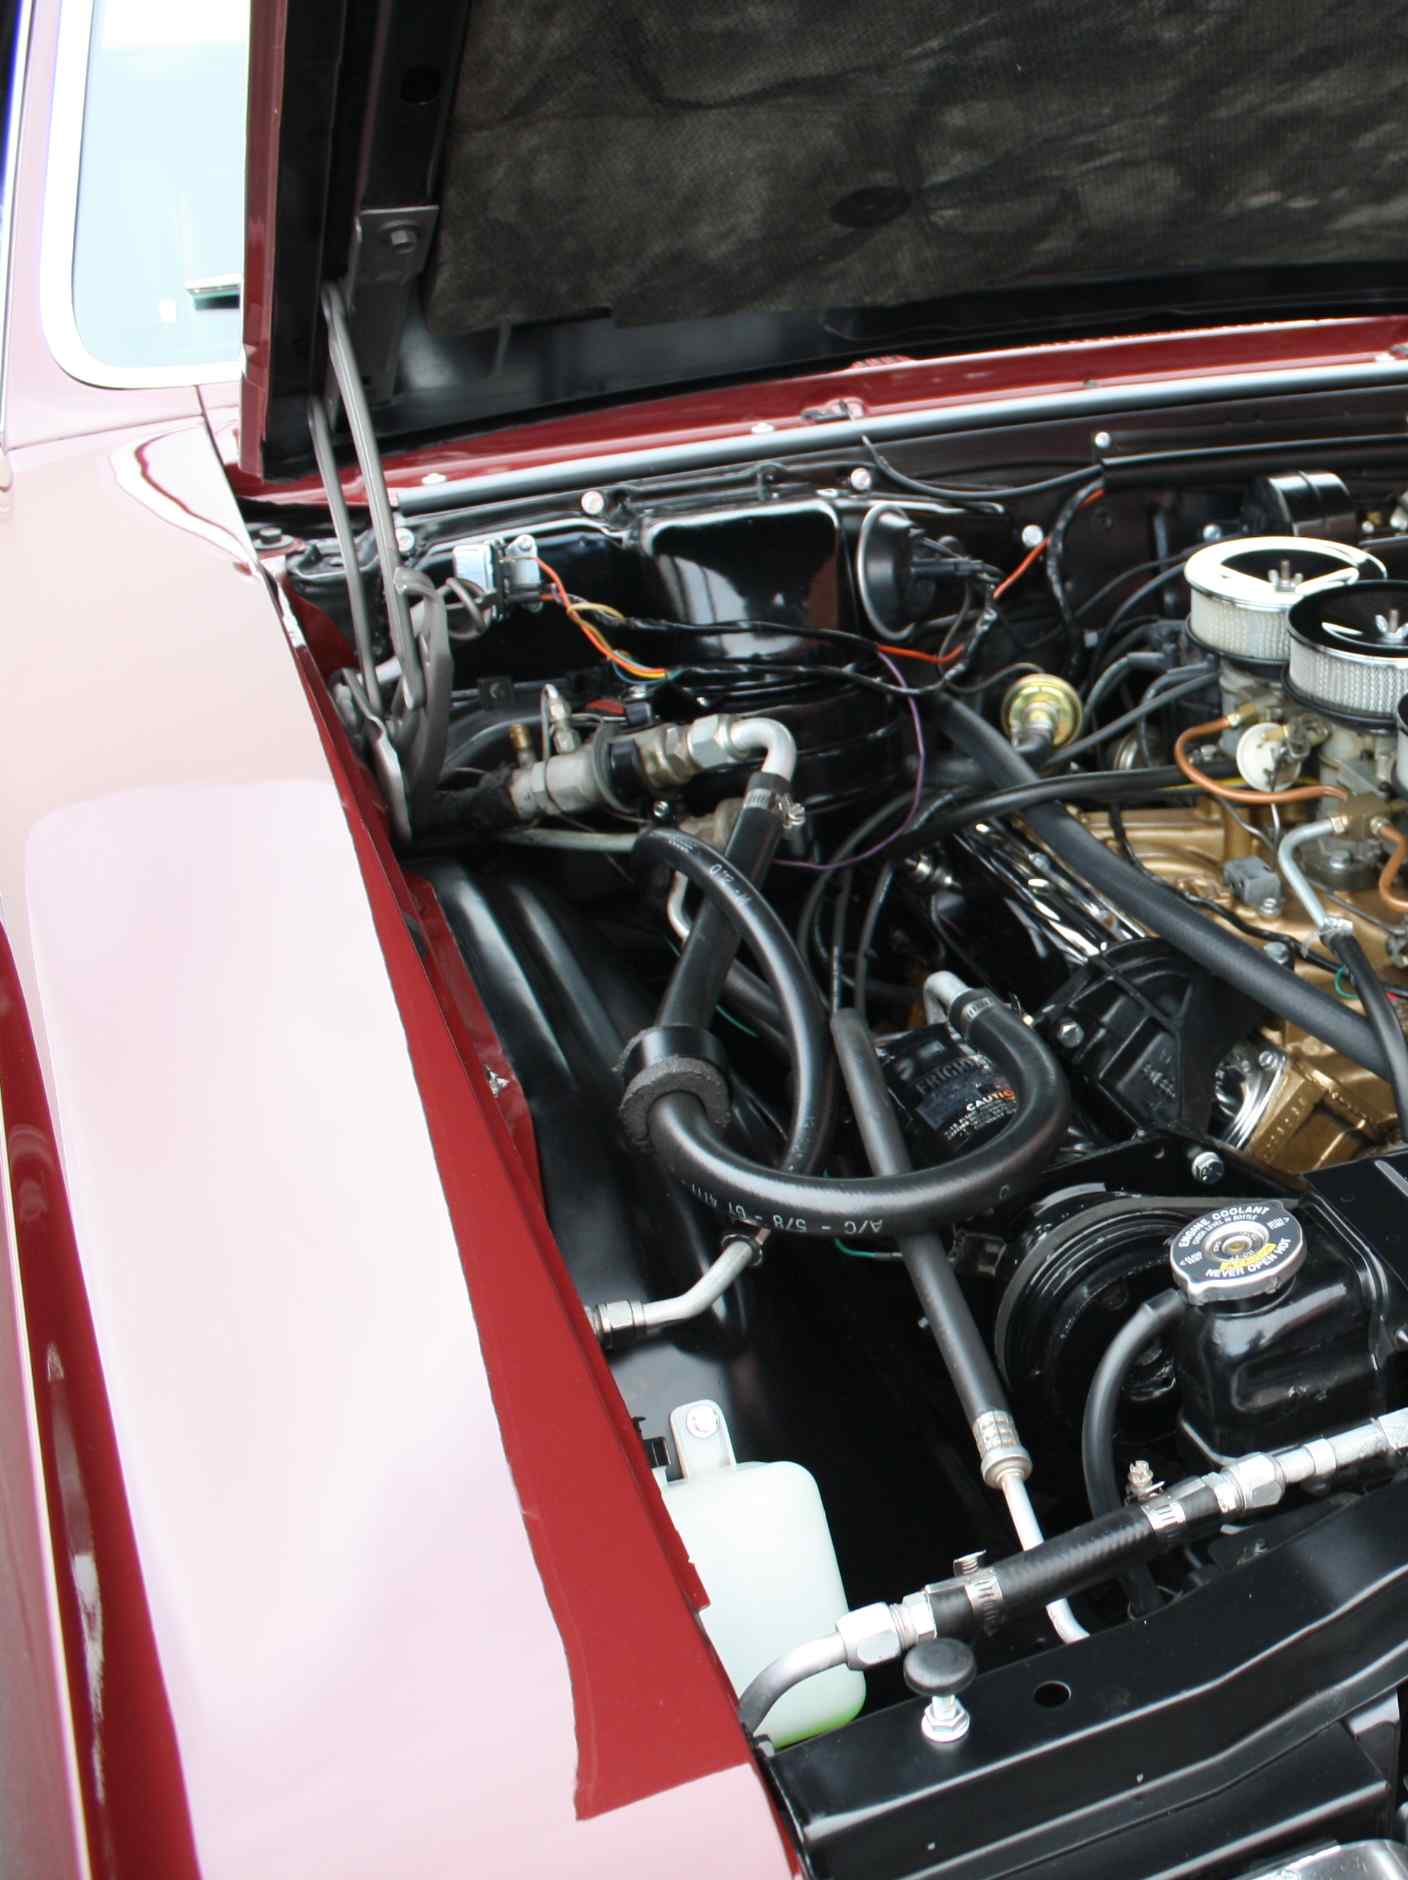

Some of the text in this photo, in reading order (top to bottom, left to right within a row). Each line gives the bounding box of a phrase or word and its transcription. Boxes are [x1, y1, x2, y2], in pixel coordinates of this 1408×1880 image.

[965, 1087, 1016, 1111] CAUTIO
[772, 1214, 808, 1232] 5/8
[843, 1219, 883, 1234] A/C
[1178, 1218, 1210, 1248] ENGINE
[1212, 1206, 1270, 1220] COOLANT
[1205, 1267, 1245, 1278] NEVER
[1247, 1254, 1278, 1272] OPEN
[1276, 1238, 1292, 1255] HOT
